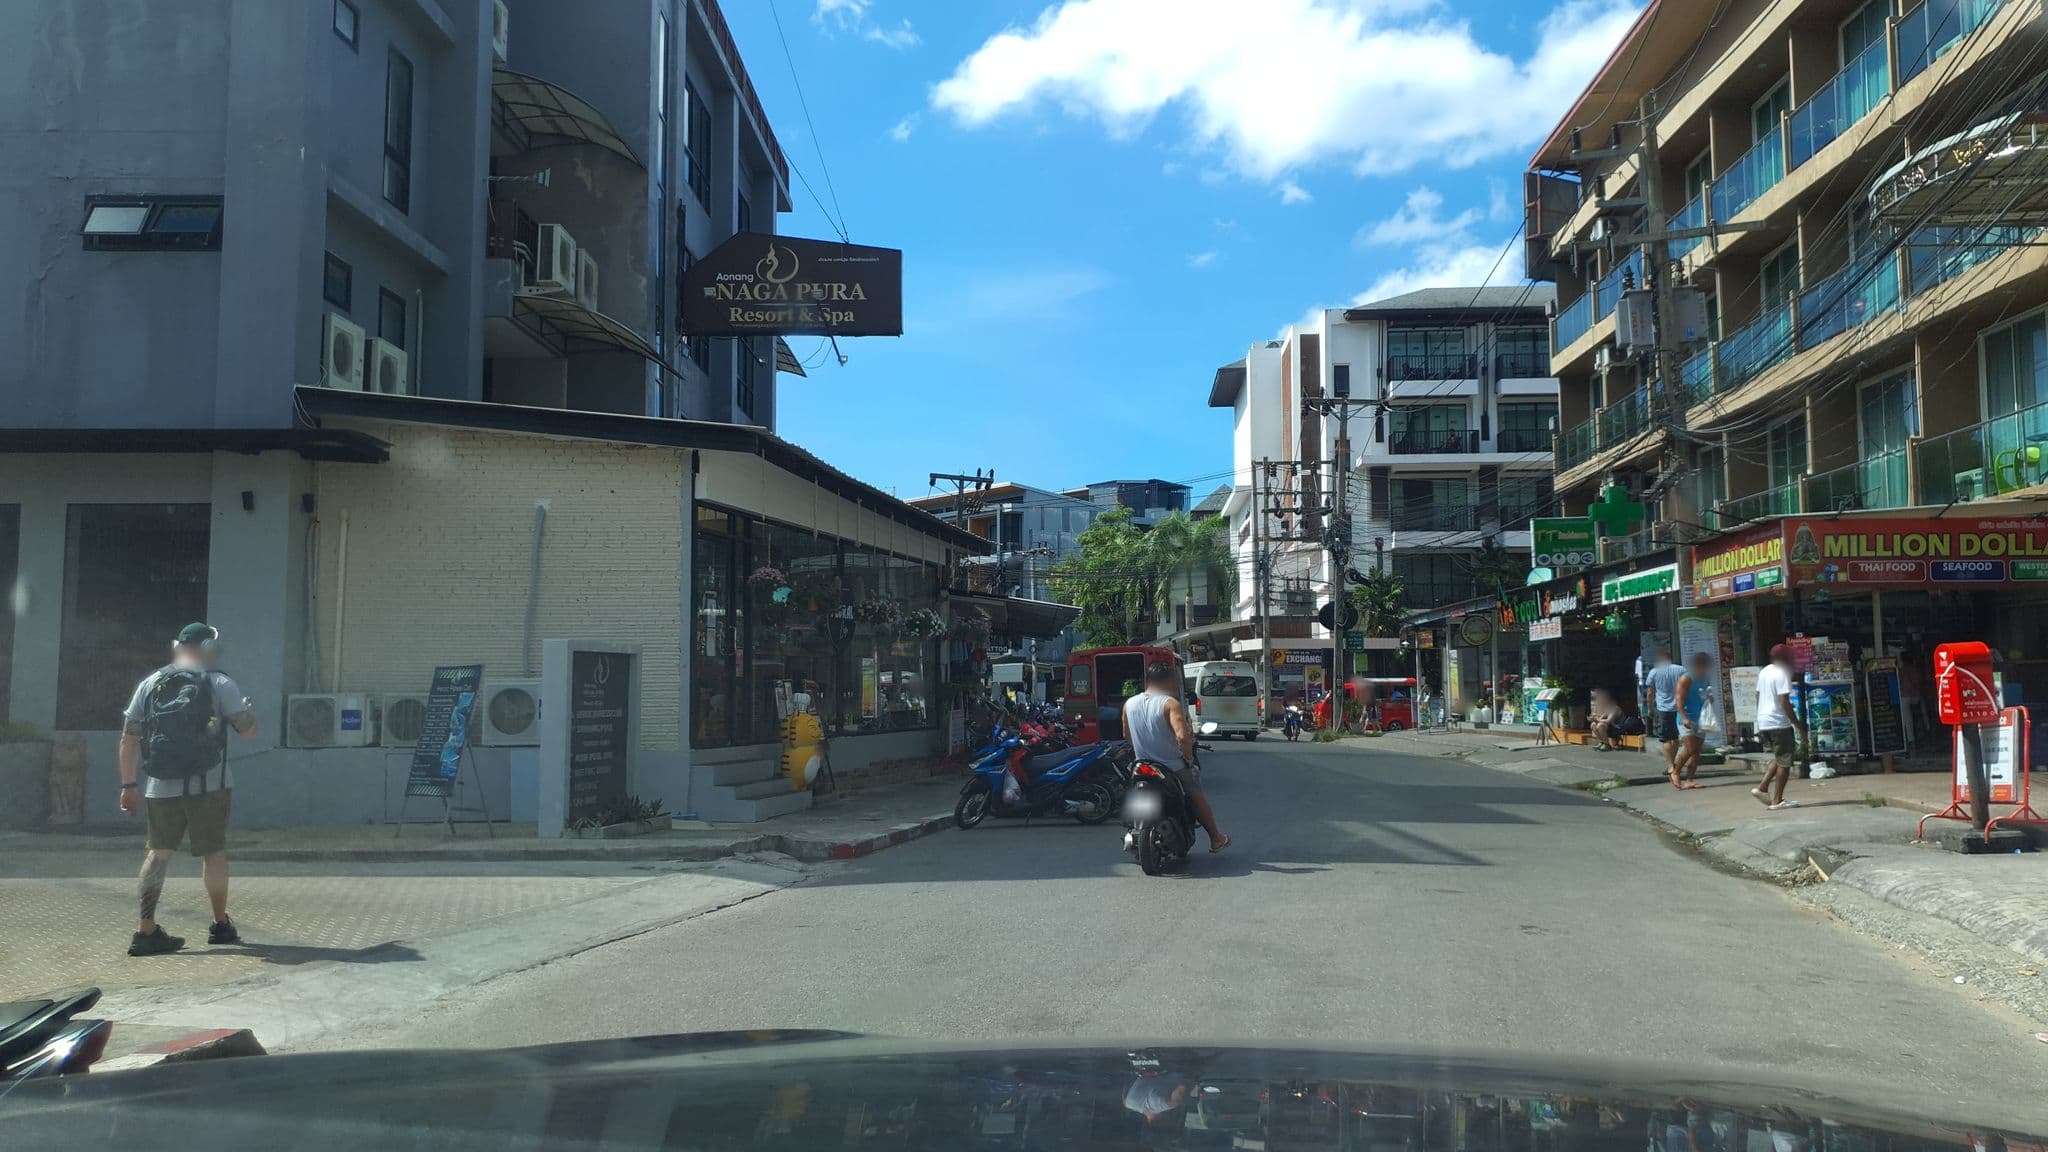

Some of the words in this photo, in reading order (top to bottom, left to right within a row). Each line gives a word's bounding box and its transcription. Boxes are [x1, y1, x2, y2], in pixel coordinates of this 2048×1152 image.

[716, 272, 754, 283] Aonang
[716, 283, 789, 301] NAGA
[796, 283, 868, 301] PURA
[729, 307, 793, 322] Resort
[799, 307, 814, 322] &
[818, 307, 855, 326] Spa
[1824, 533, 1950, 557] MILLION
[1702, 549, 1738, 578] MILLION
[1740, 538, 1781, 568] DOLLAR
[1943, 562, 1993, 571] SEAFOOD
[1859, 563, 1884, 572] THAI
[1886, 563, 1916, 571] FOOD
